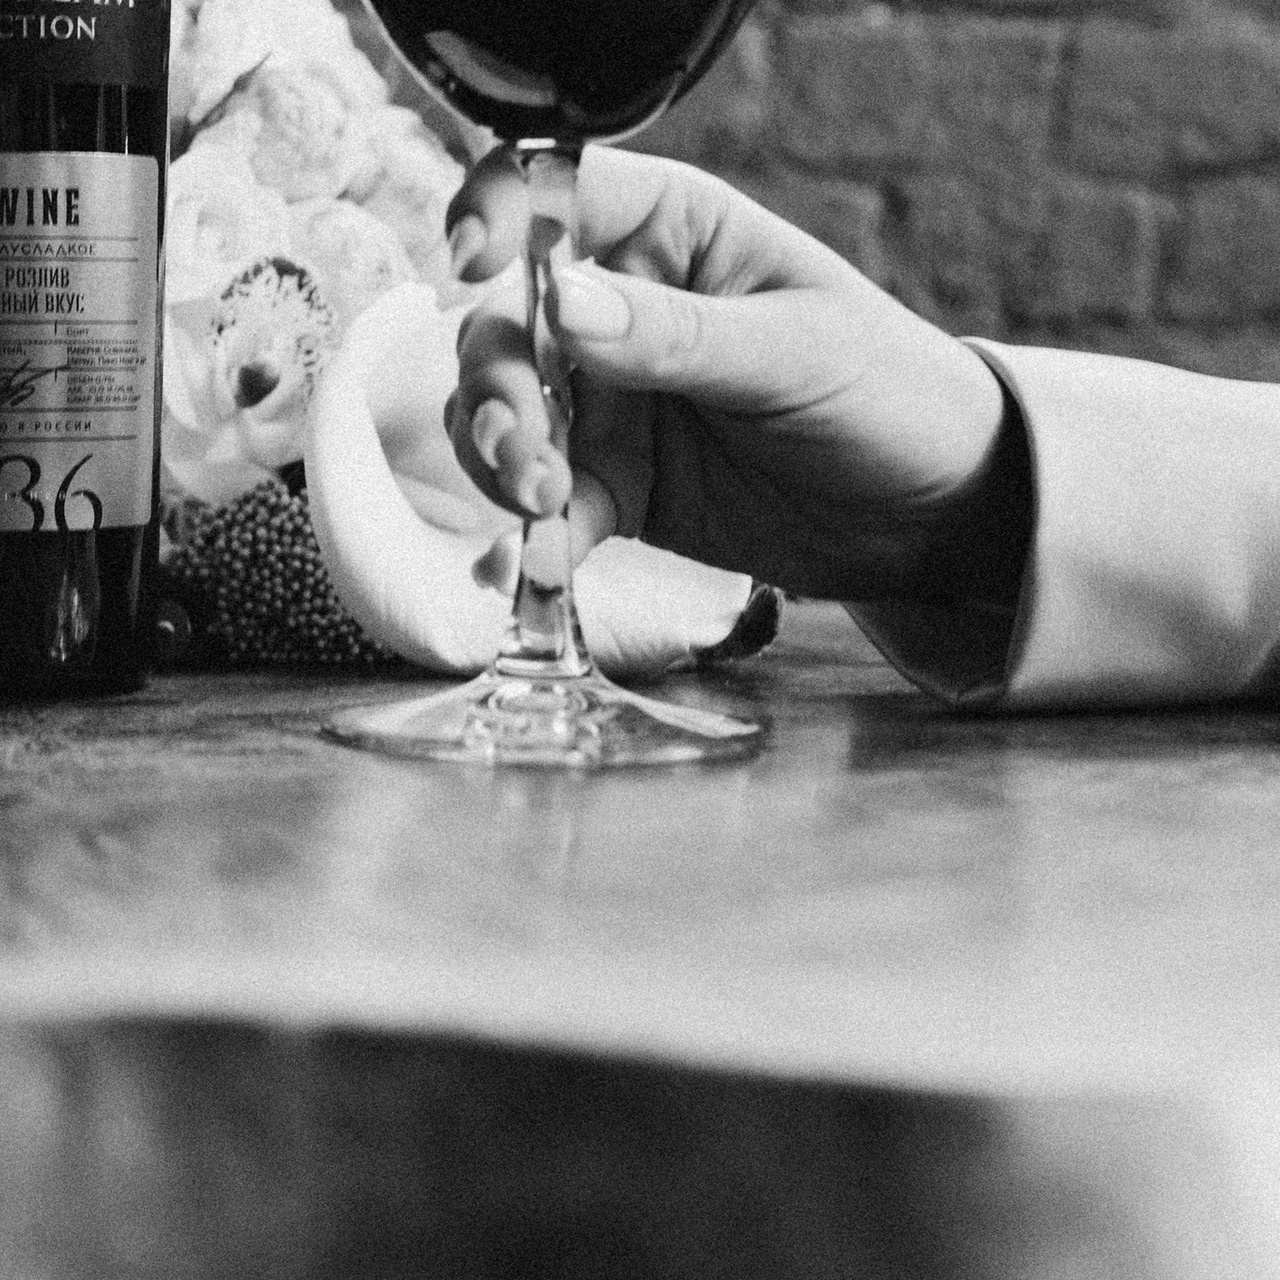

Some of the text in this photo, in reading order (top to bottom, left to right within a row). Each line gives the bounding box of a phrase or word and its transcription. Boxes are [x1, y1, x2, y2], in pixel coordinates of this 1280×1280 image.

[5, 267, 70, 289] РОЗЛИВ
[44, 292, 86, 314] ВКУС
[34, 421, 92, 432] РОССИИ
